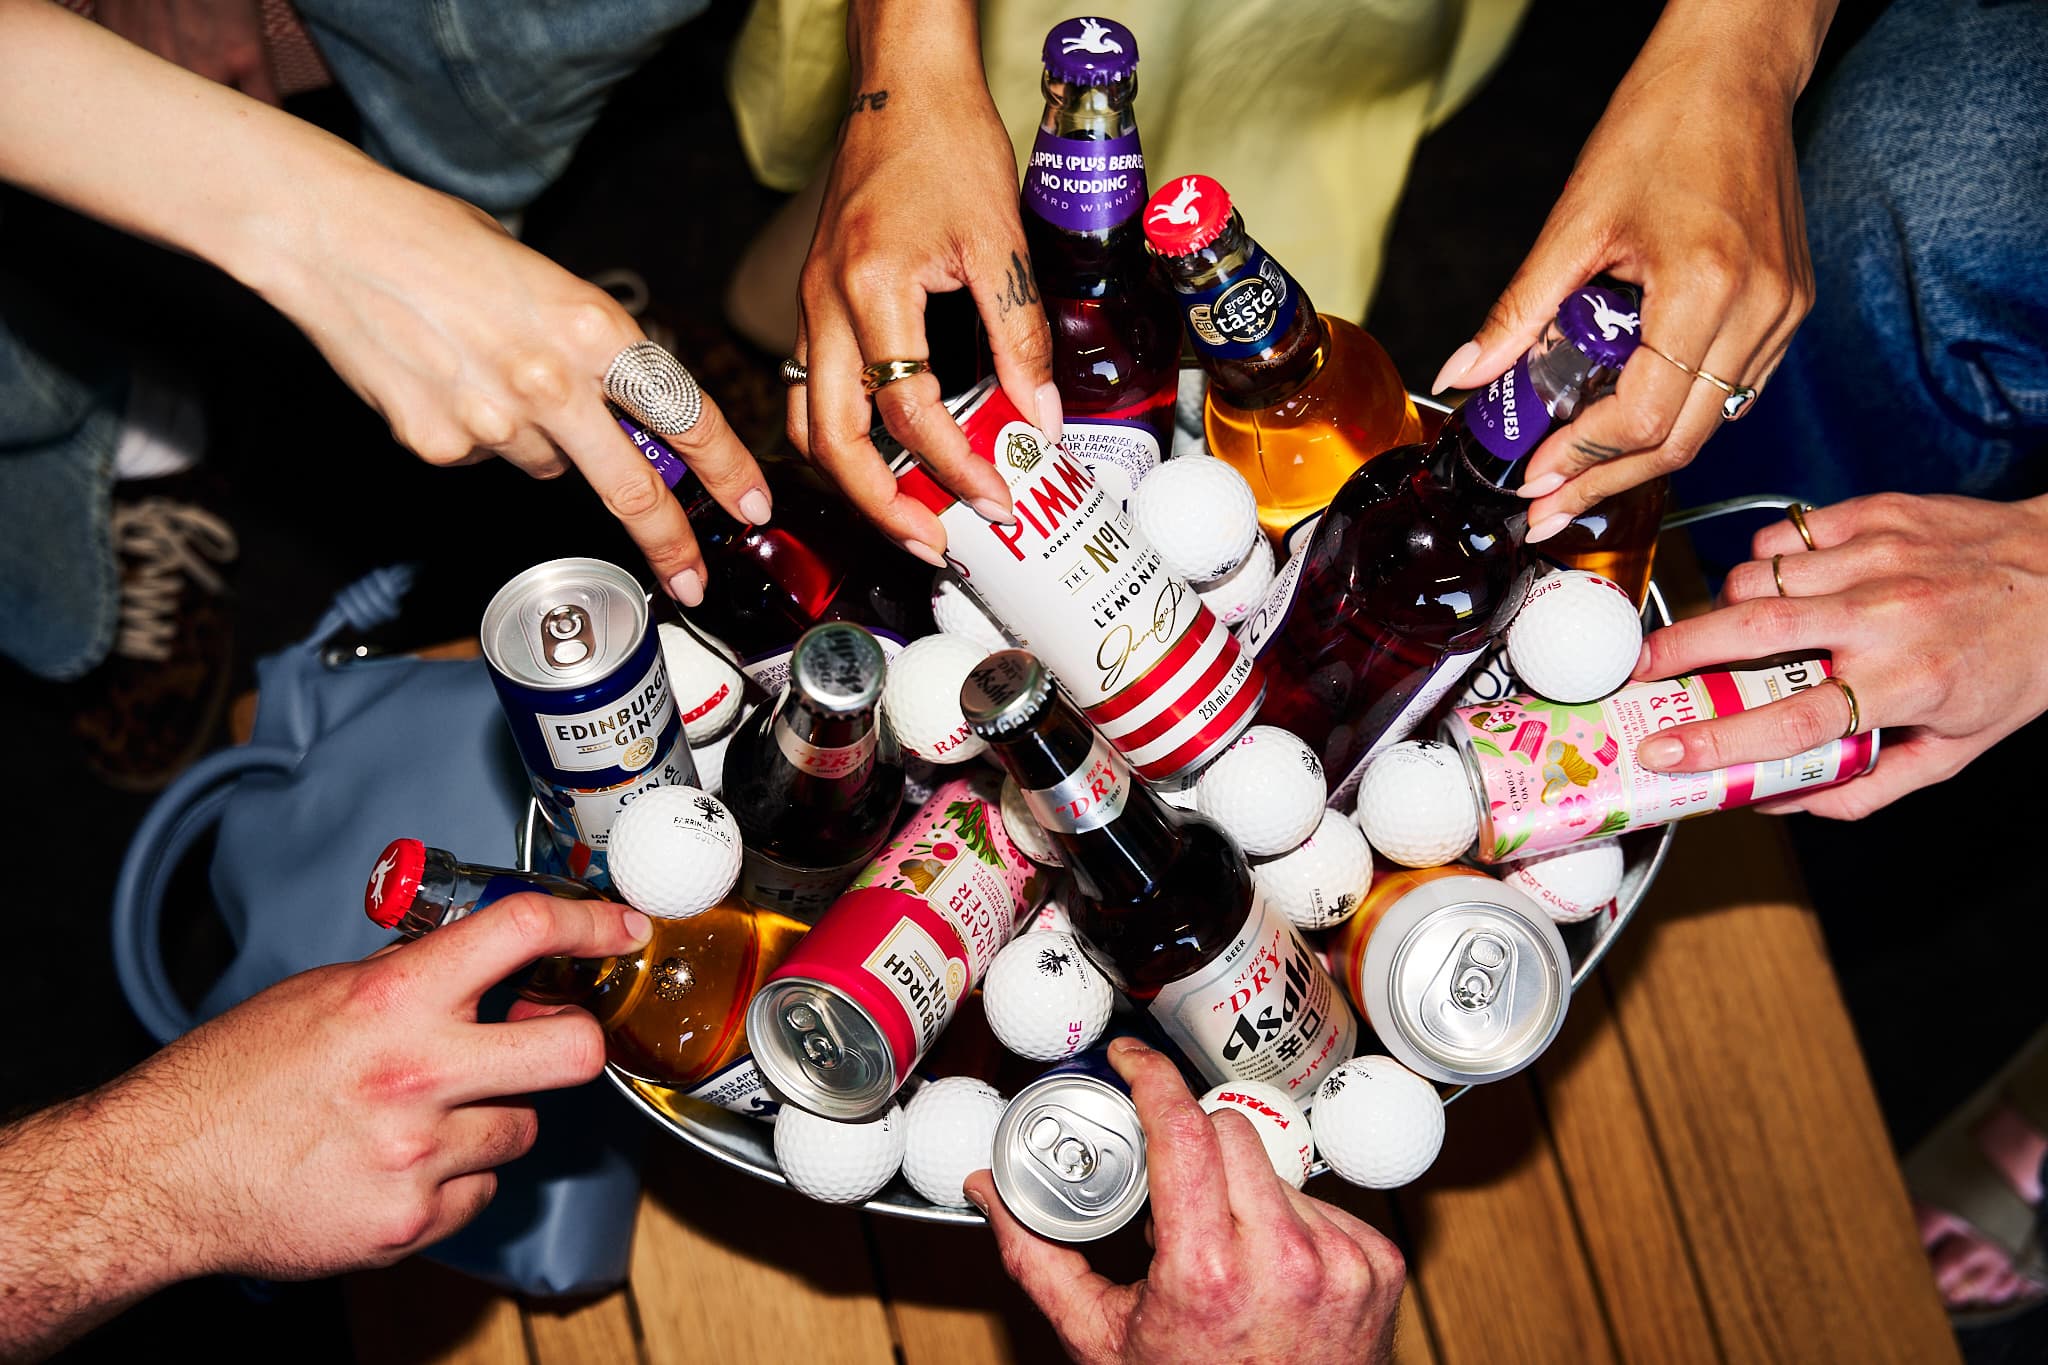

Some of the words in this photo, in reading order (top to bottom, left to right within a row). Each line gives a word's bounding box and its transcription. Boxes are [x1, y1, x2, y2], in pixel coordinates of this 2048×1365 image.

[1066, 155, 1106, 171] (PLUS
[1041, 172, 1060, 189] NO
[1063, 175, 1127, 193] KIDDING
[1216, 288, 1275, 333] taste
[1224, 286, 1257, 315] great
[1502, 369, 1521, 441] BERRIES)
[1043, 532, 1071, 559] BORN
[1072, 518, 1085, 531] IN
[1064, 565, 1089, 589] THE
[1093, 553, 1162, 629] LEMONAD
[555, 659, 667, 741] EDINBURGH
[1199, 700, 1218, 721] 250
[1649, 696, 1668, 711] &
[614, 711, 652, 746] GIN
[932, 721, 974, 756] RAN
[664, 764, 676, 780] &
[957, 883, 996, 961] INGER
[1224, 939, 1247, 963] BEER
[1233, 945, 1267, 988] SUPER
[1222, 929, 1313, 1062] Asahi
[1275, 1007, 1321, 1063] 辛口
[735, 1069, 757, 1084] APP
